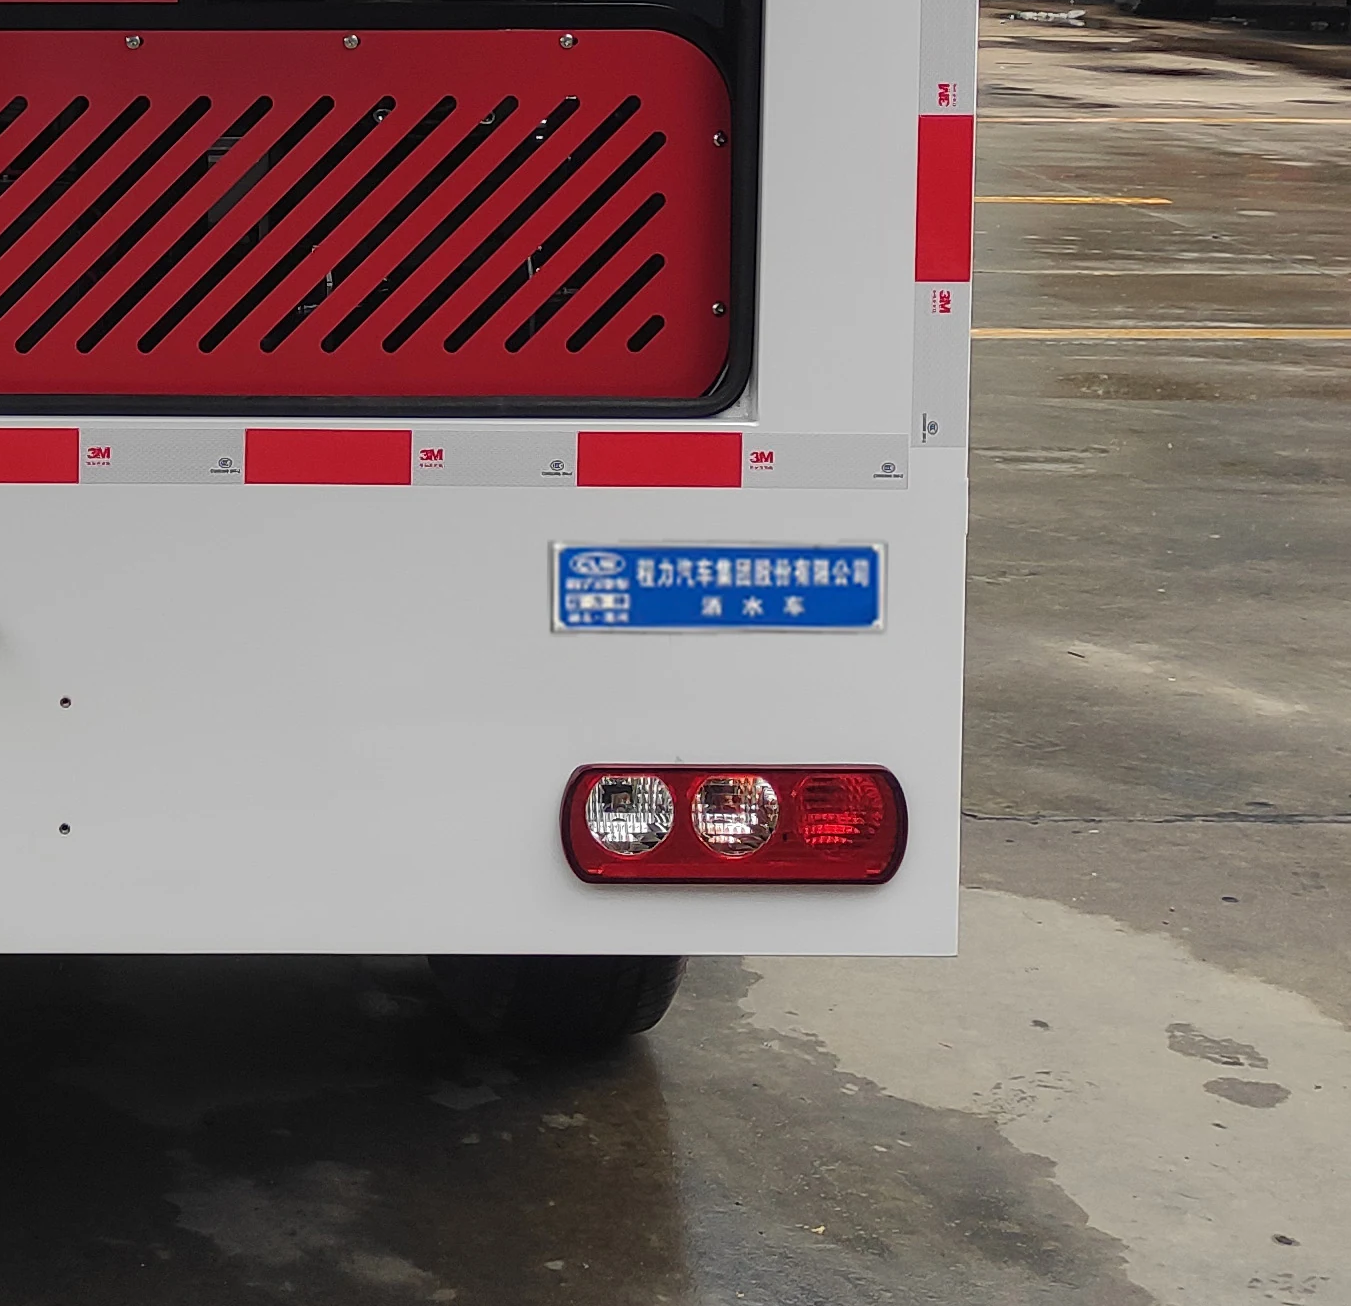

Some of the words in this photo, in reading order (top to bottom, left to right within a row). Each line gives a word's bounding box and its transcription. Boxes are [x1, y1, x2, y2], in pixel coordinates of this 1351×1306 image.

[938, 82, 951, 107] 3M
[938, 290, 951, 314] 3M
[87, 446, 111, 460] 3M
[419, 449, 444, 461] 3M
[749, 451, 775, 464] 3M
